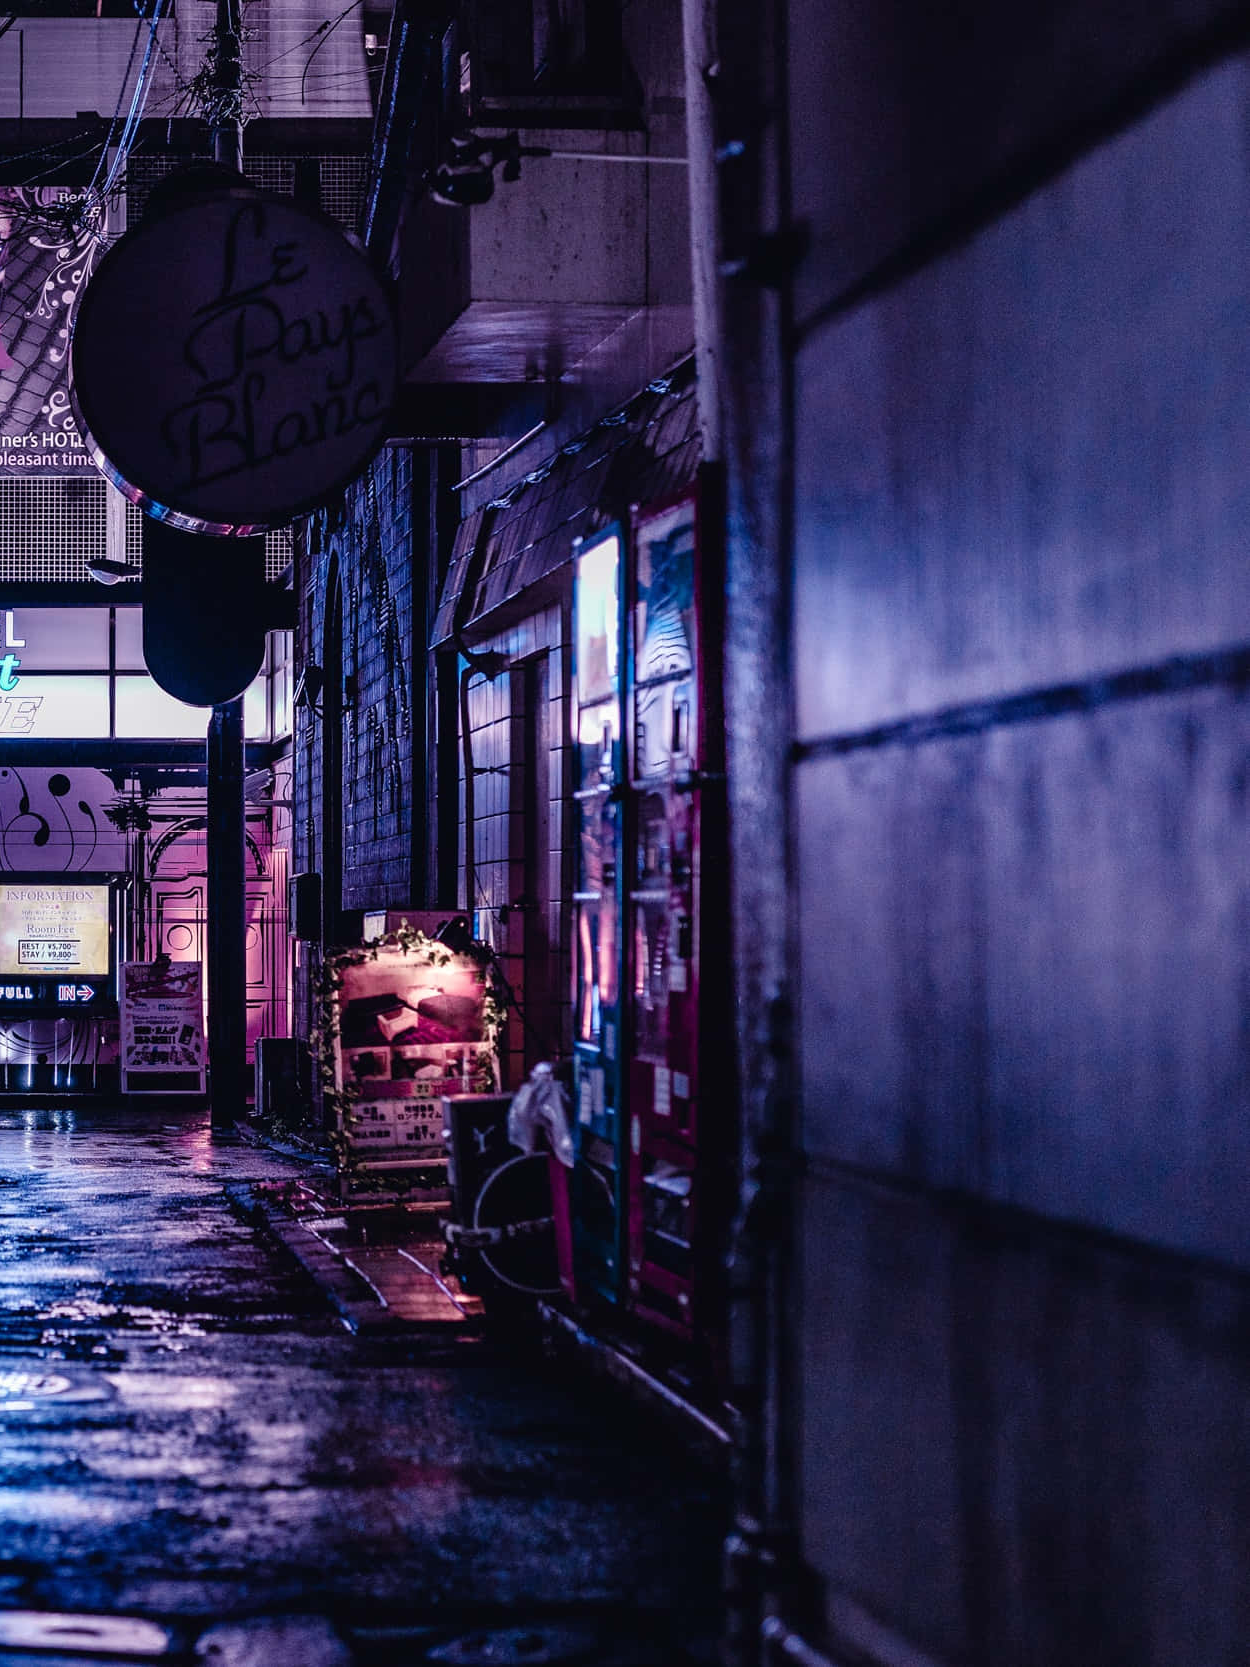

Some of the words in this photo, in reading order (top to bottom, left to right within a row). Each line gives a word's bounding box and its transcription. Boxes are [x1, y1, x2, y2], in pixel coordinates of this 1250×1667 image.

[184, 296, 383, 394] Pays
[161, 371, 389, 490] Blanc
[7, 890, 95, 901] INFORMATION
[27, 923, 56, 934] Room
[58, 985, 76, 1001] IN
